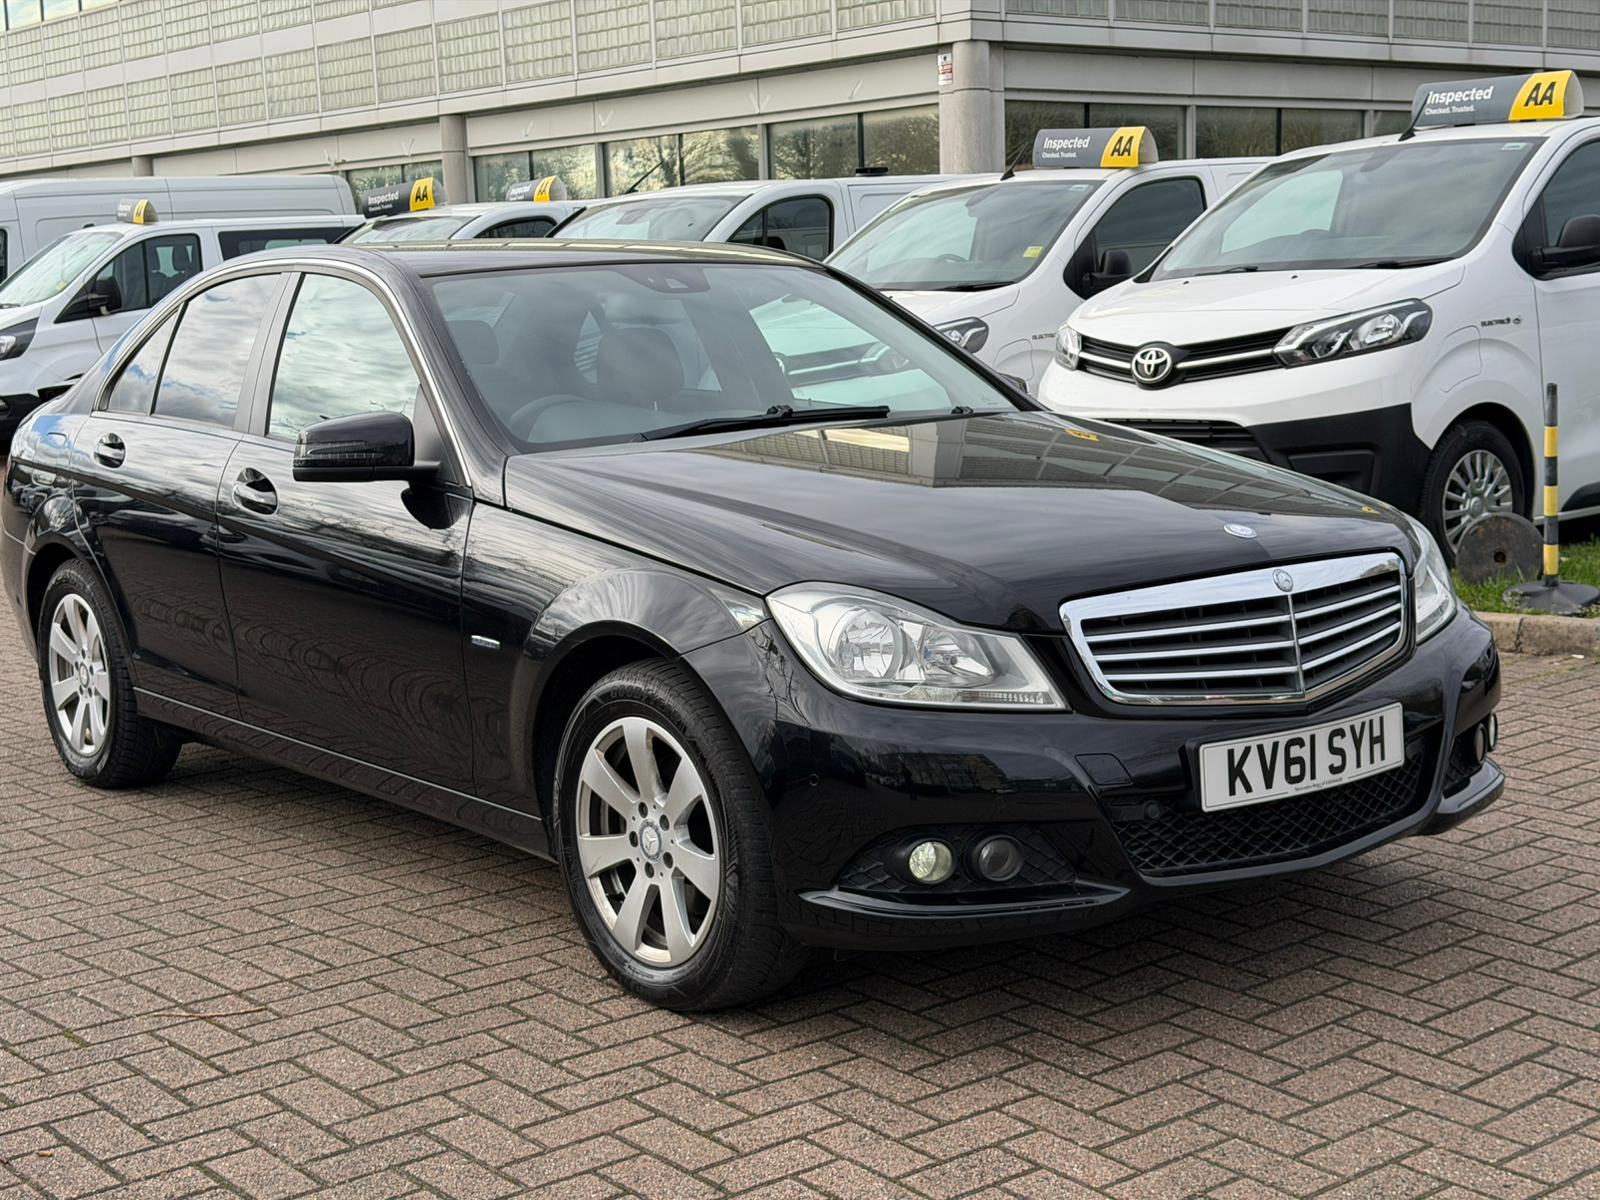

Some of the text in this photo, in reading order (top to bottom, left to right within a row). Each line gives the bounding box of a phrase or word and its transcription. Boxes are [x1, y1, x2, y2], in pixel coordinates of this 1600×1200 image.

[1427, 86, 1494, 105] Inspected
[1524, 81, 1557, 107] AA
[1043, 136, 1090, 150] Inspected
[1111, 136, 1134, 156] AA
[368, 190, 399, 205] Inspected
[415, 185, 429, 202] AA
[1227, 715, 1385, 797] KV61 SYH
